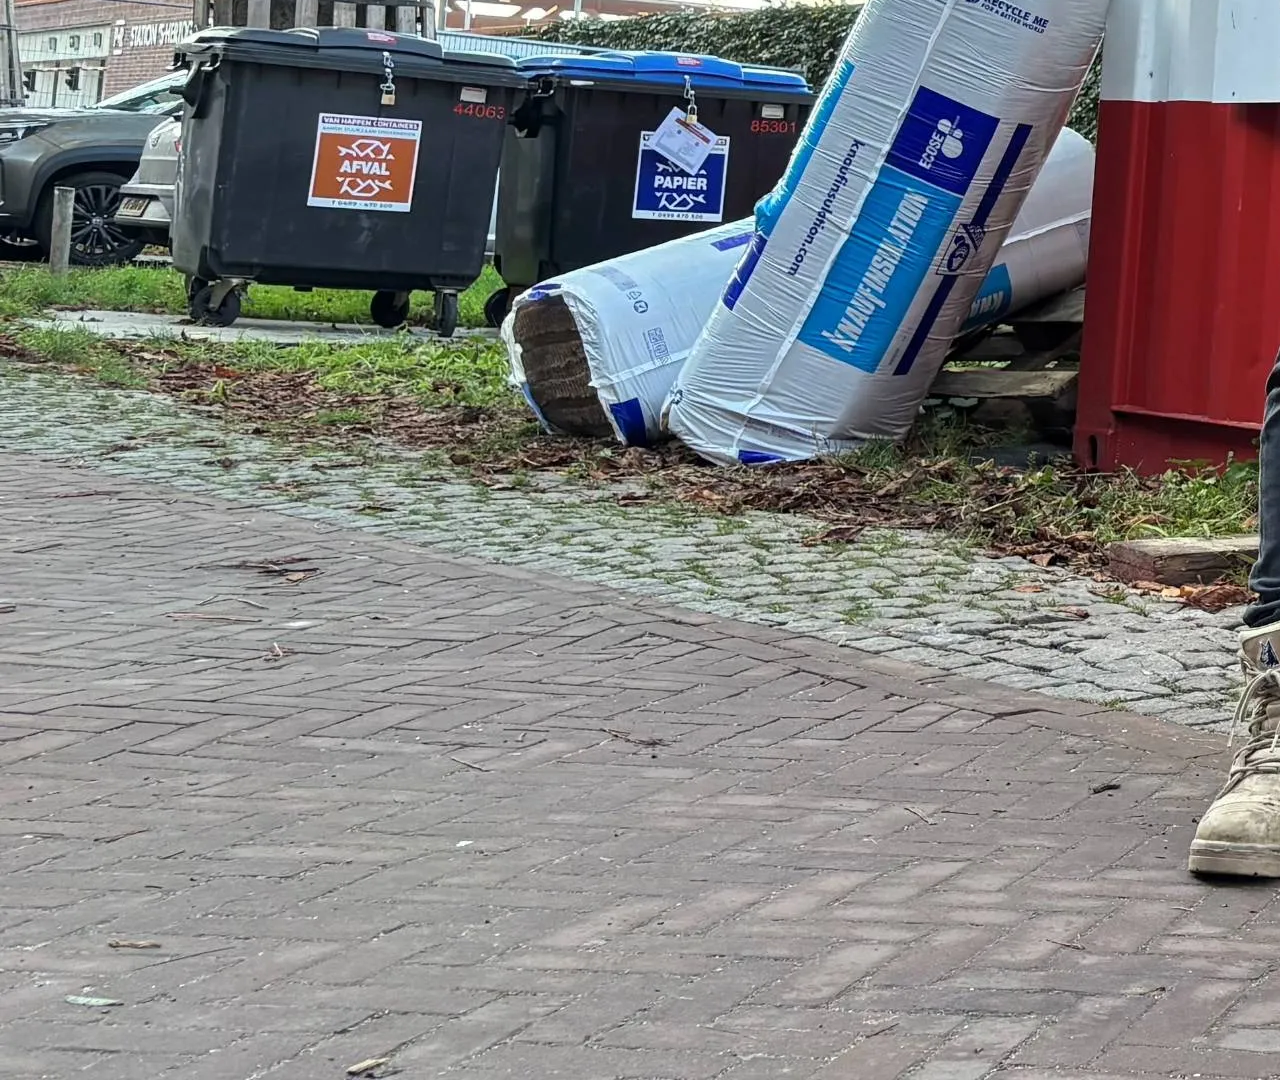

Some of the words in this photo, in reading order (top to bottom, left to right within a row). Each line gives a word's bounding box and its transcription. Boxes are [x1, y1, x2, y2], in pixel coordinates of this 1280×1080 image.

[981, 3, 994, 12] FOR
[1000, 12, 1022, 25] BETTER
[1022, 22, 1045, 34] WORLD
[1032, 16, 1049, 28] ME
[453, 103, 505, 120] 44063
[323, 116, 340, 124] VAN
[341, 118, 371, 126] HAPPEN
[373, 120, 418, 129] CONTAINERS
[751, 120, 796, 133] 85301
[918, 129, 945, 170] ECOSE
[340, 160, 390, 175] AFVAL
[654, 175, 708, 190] PAPIER
[788, 138, 866, 277] knaufinsulation.com
